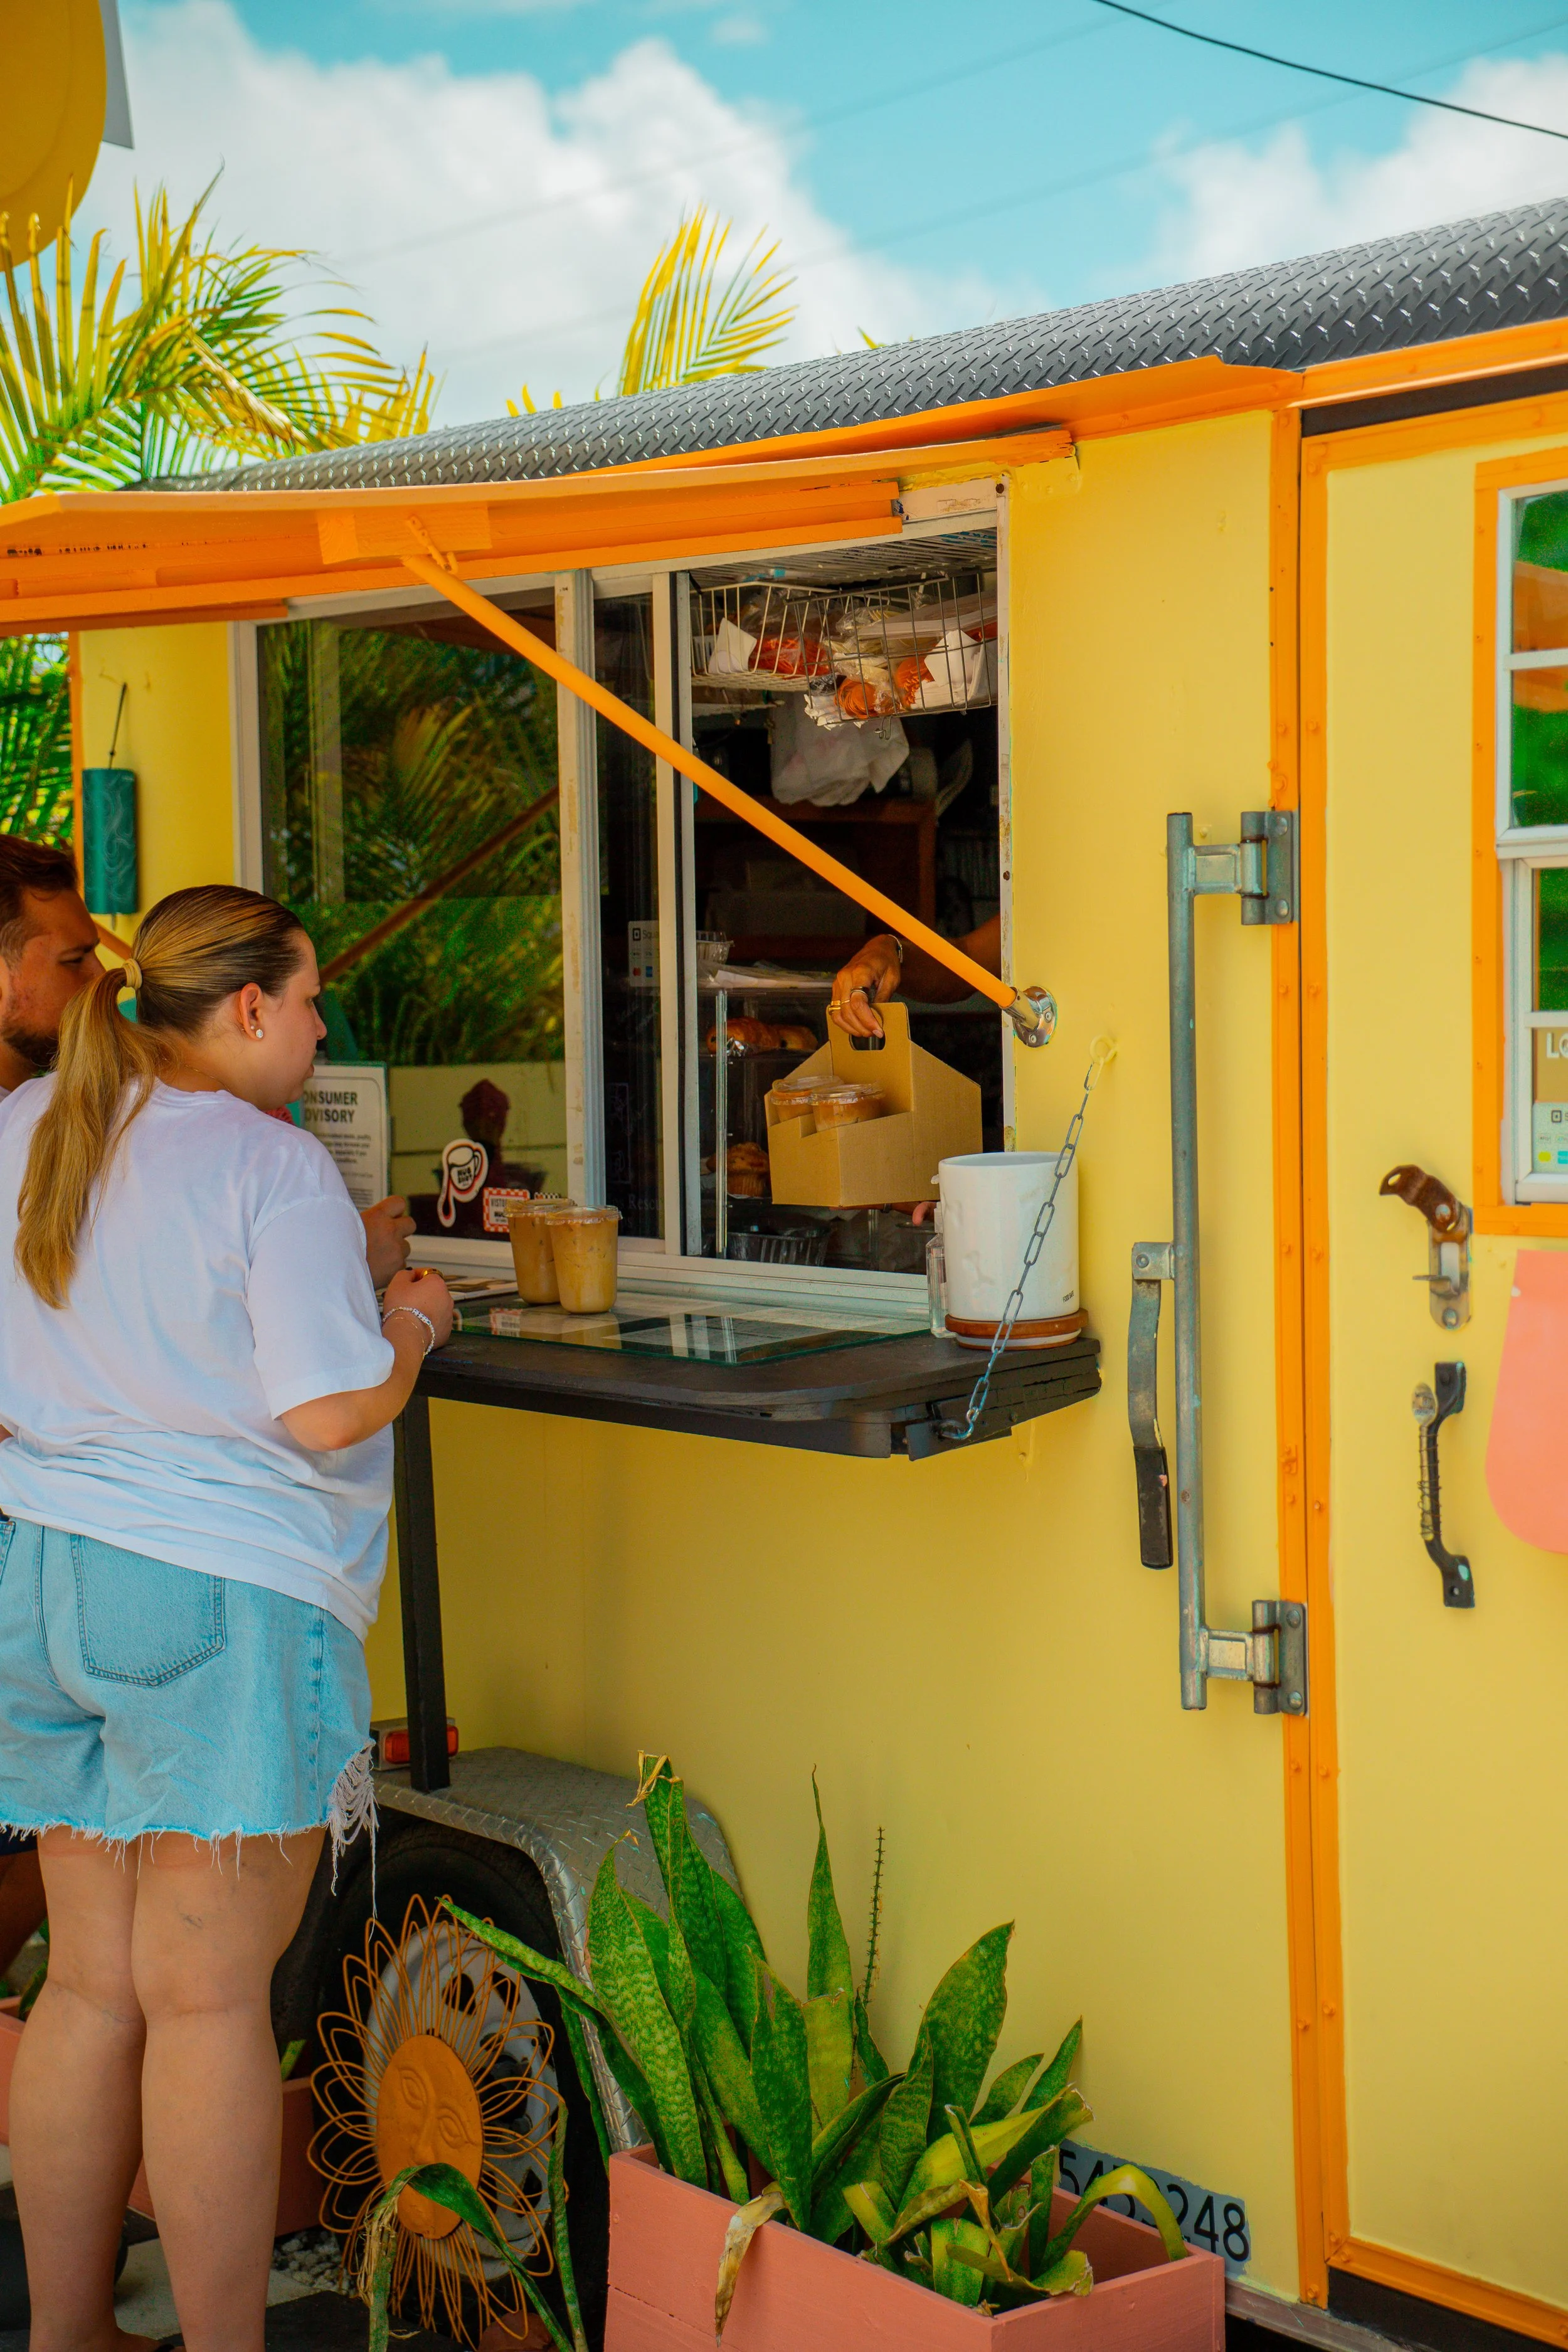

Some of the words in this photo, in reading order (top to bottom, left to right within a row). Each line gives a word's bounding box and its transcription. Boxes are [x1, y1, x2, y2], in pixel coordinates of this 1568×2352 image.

[643, 930, 659, 941] Squa
[304, 1091, 358, 1105] ONSUMER
[305, 1108, 355, 1123] DVISORY
